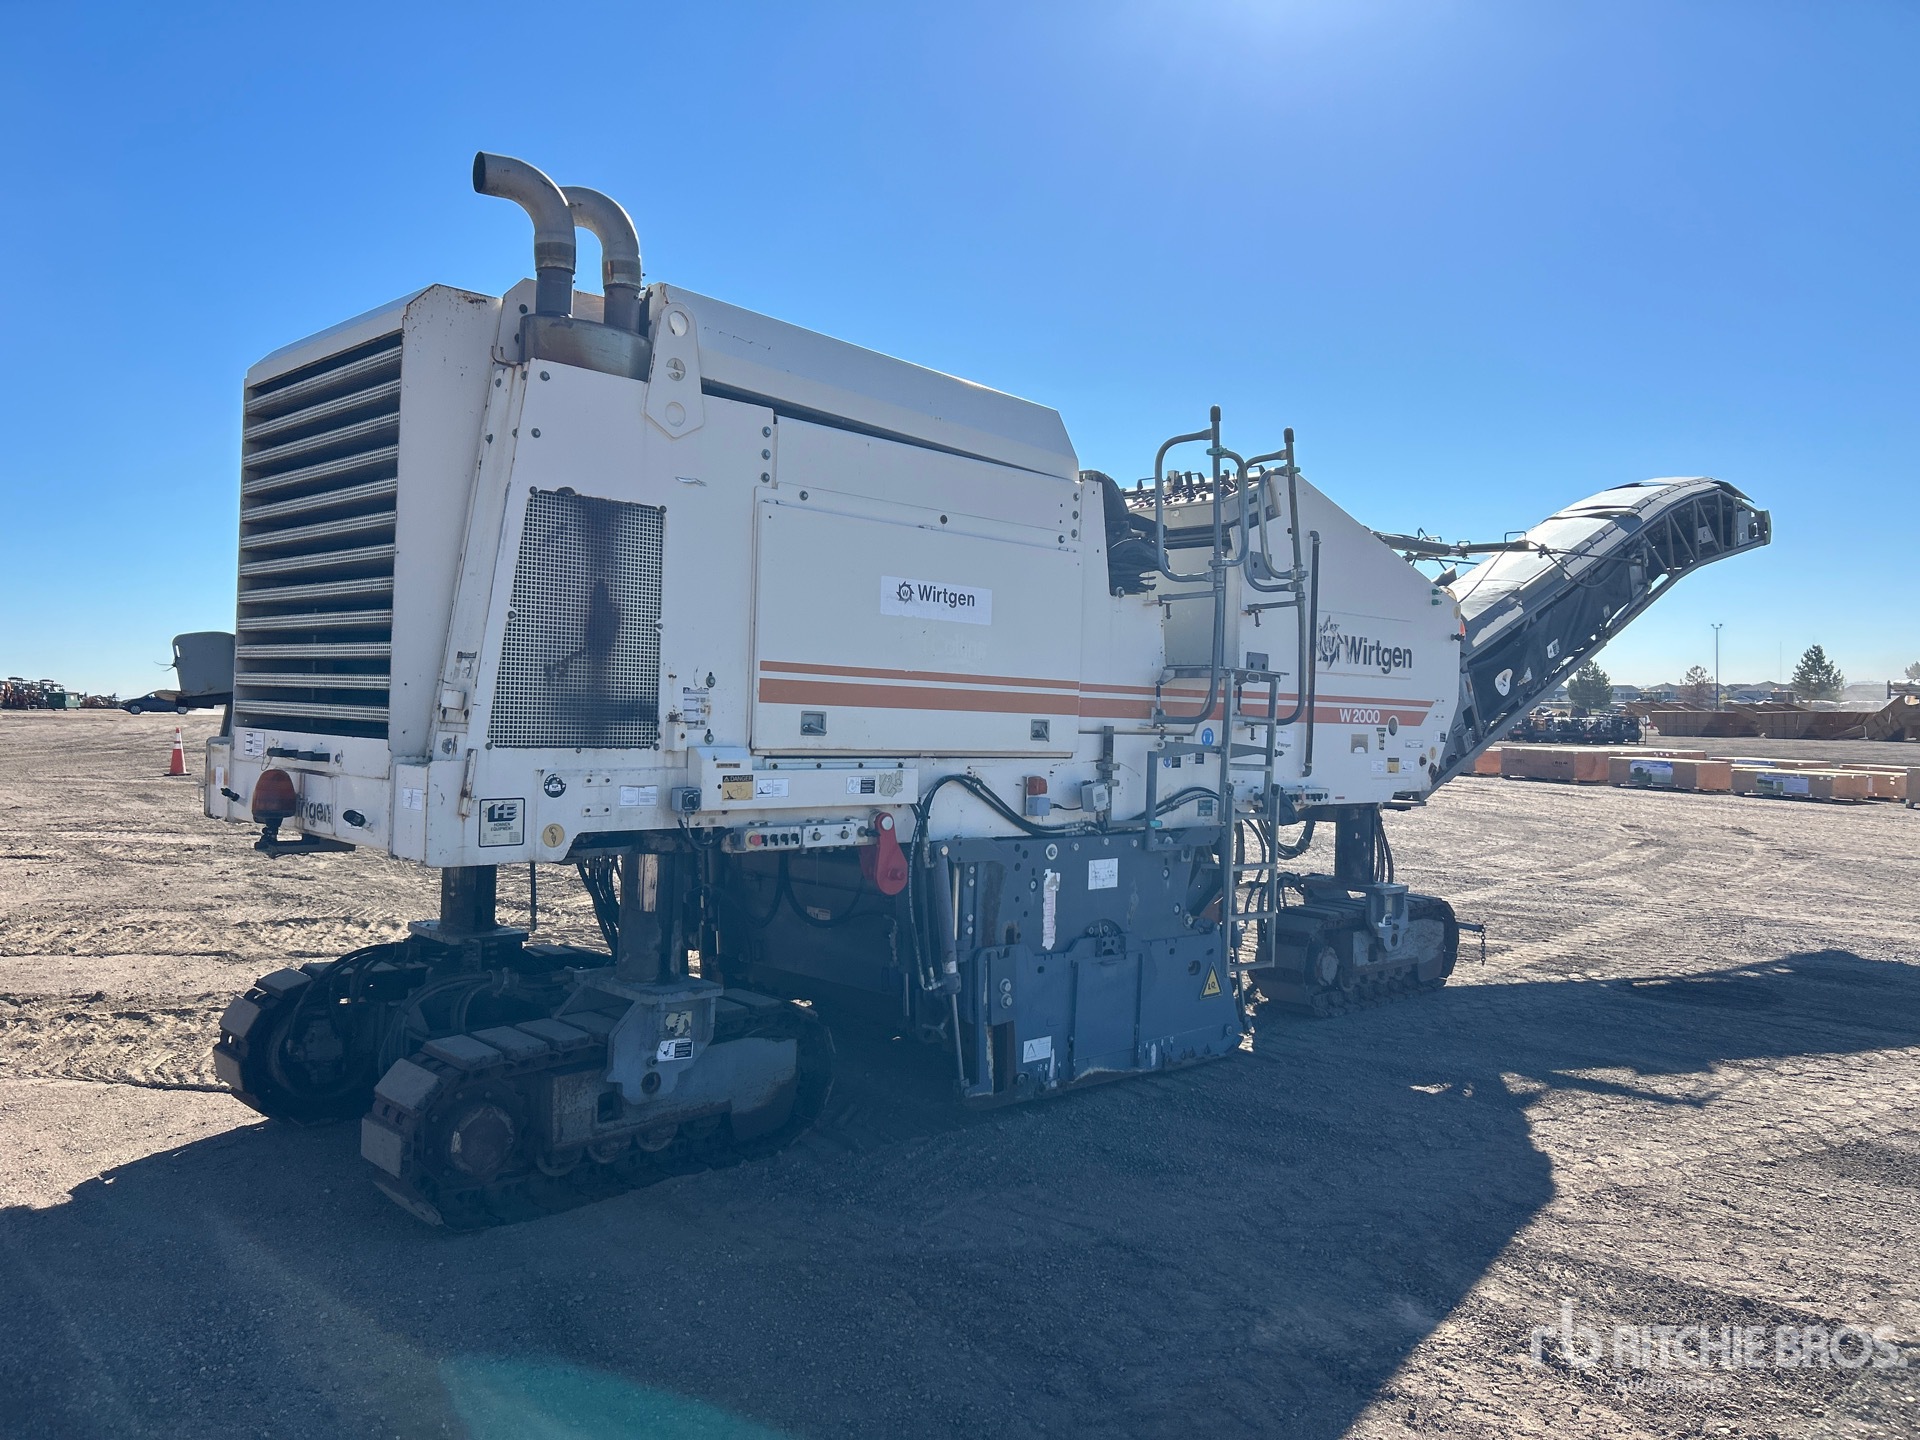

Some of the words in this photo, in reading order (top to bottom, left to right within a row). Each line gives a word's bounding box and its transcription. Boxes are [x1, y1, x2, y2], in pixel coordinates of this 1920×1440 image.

[917, 584, 976, 608] Wirtgen
[1344, 634, 1413, 674] Wirtgen
[1339, 708, 1380, 724] W2000
[296, 794, 333, 826] irtgen
[488, 804, 517, 822] HE
